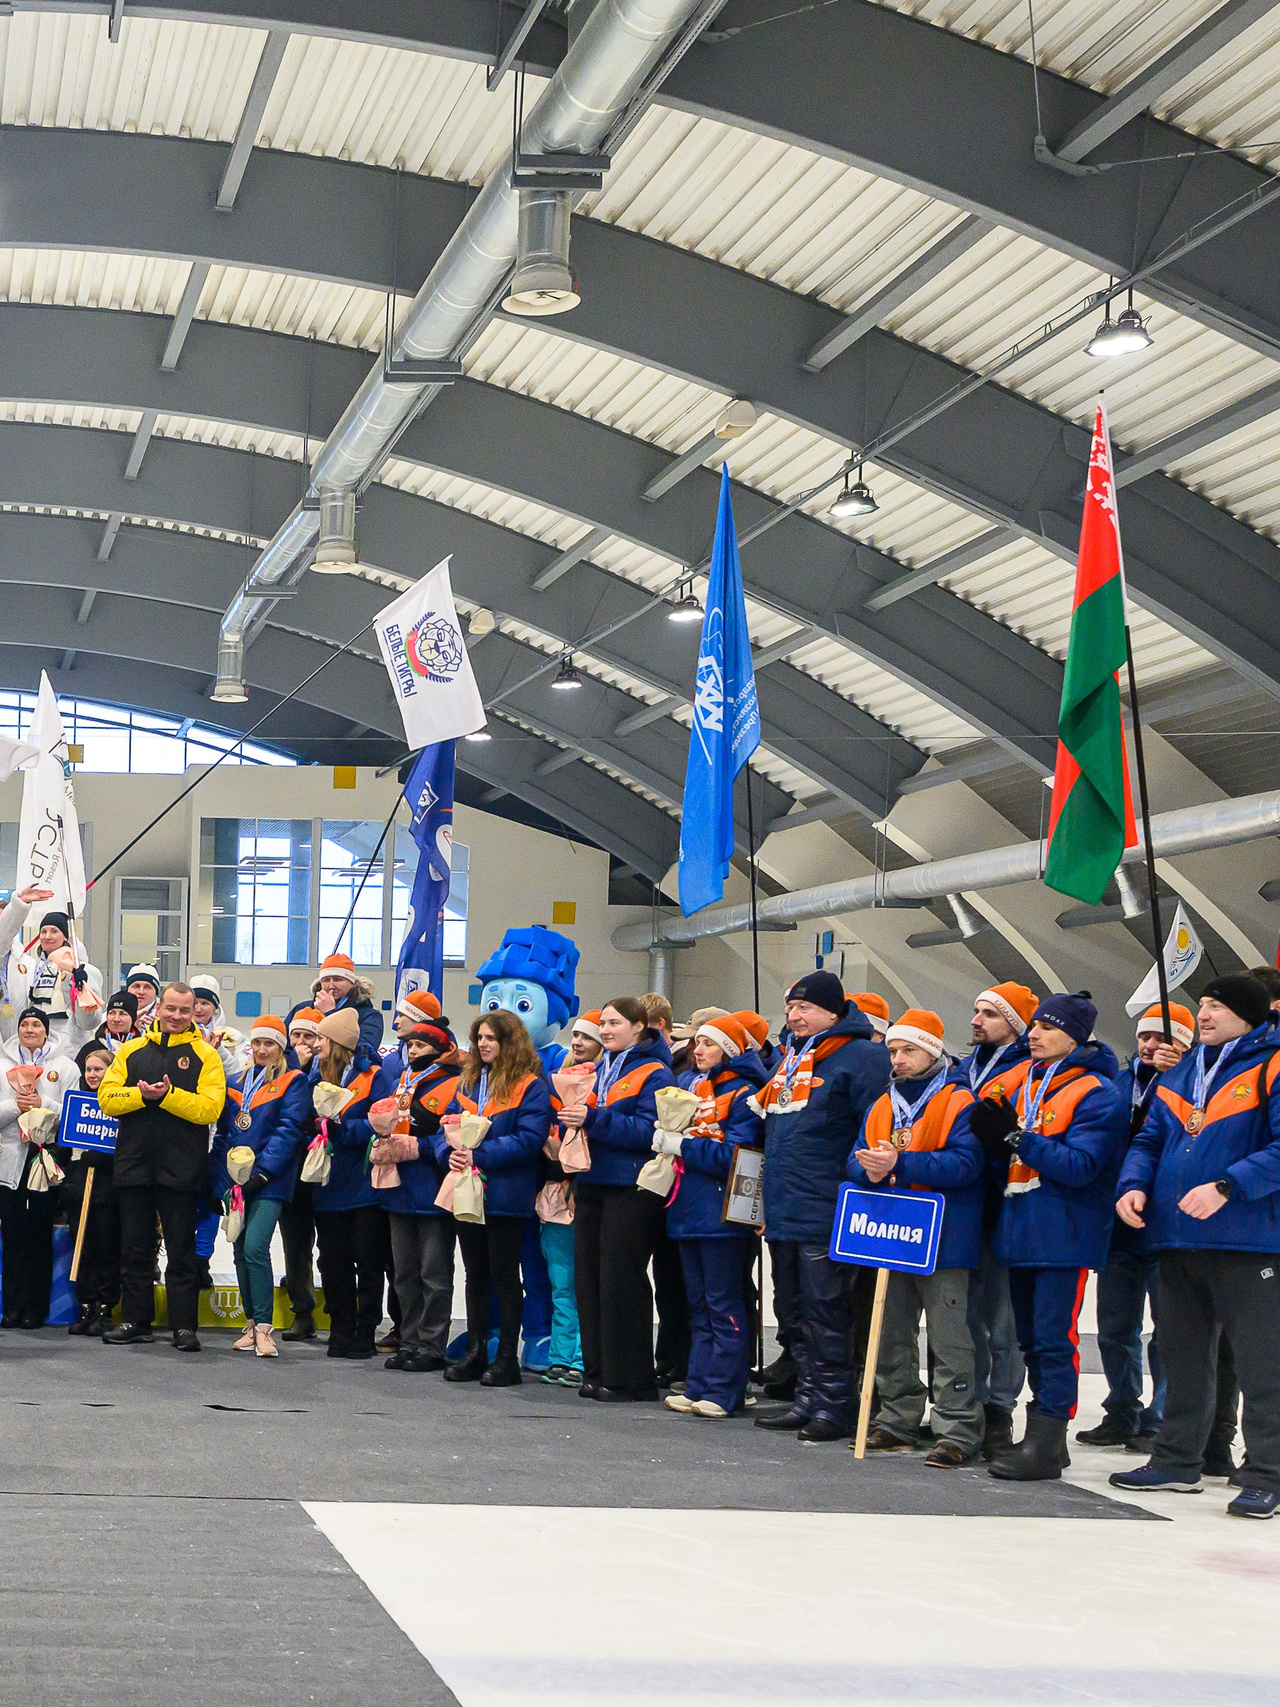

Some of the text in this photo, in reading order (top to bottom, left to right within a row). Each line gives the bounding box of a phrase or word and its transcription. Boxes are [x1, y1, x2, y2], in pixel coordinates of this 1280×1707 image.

[386, 624, 407, 662] БЕЛЫЕ
[396, 659, 417, 698] ТИГРЫ
[76, 1122, 119, 1141] тигры
[849, 1212, 924, 1244] Молния
